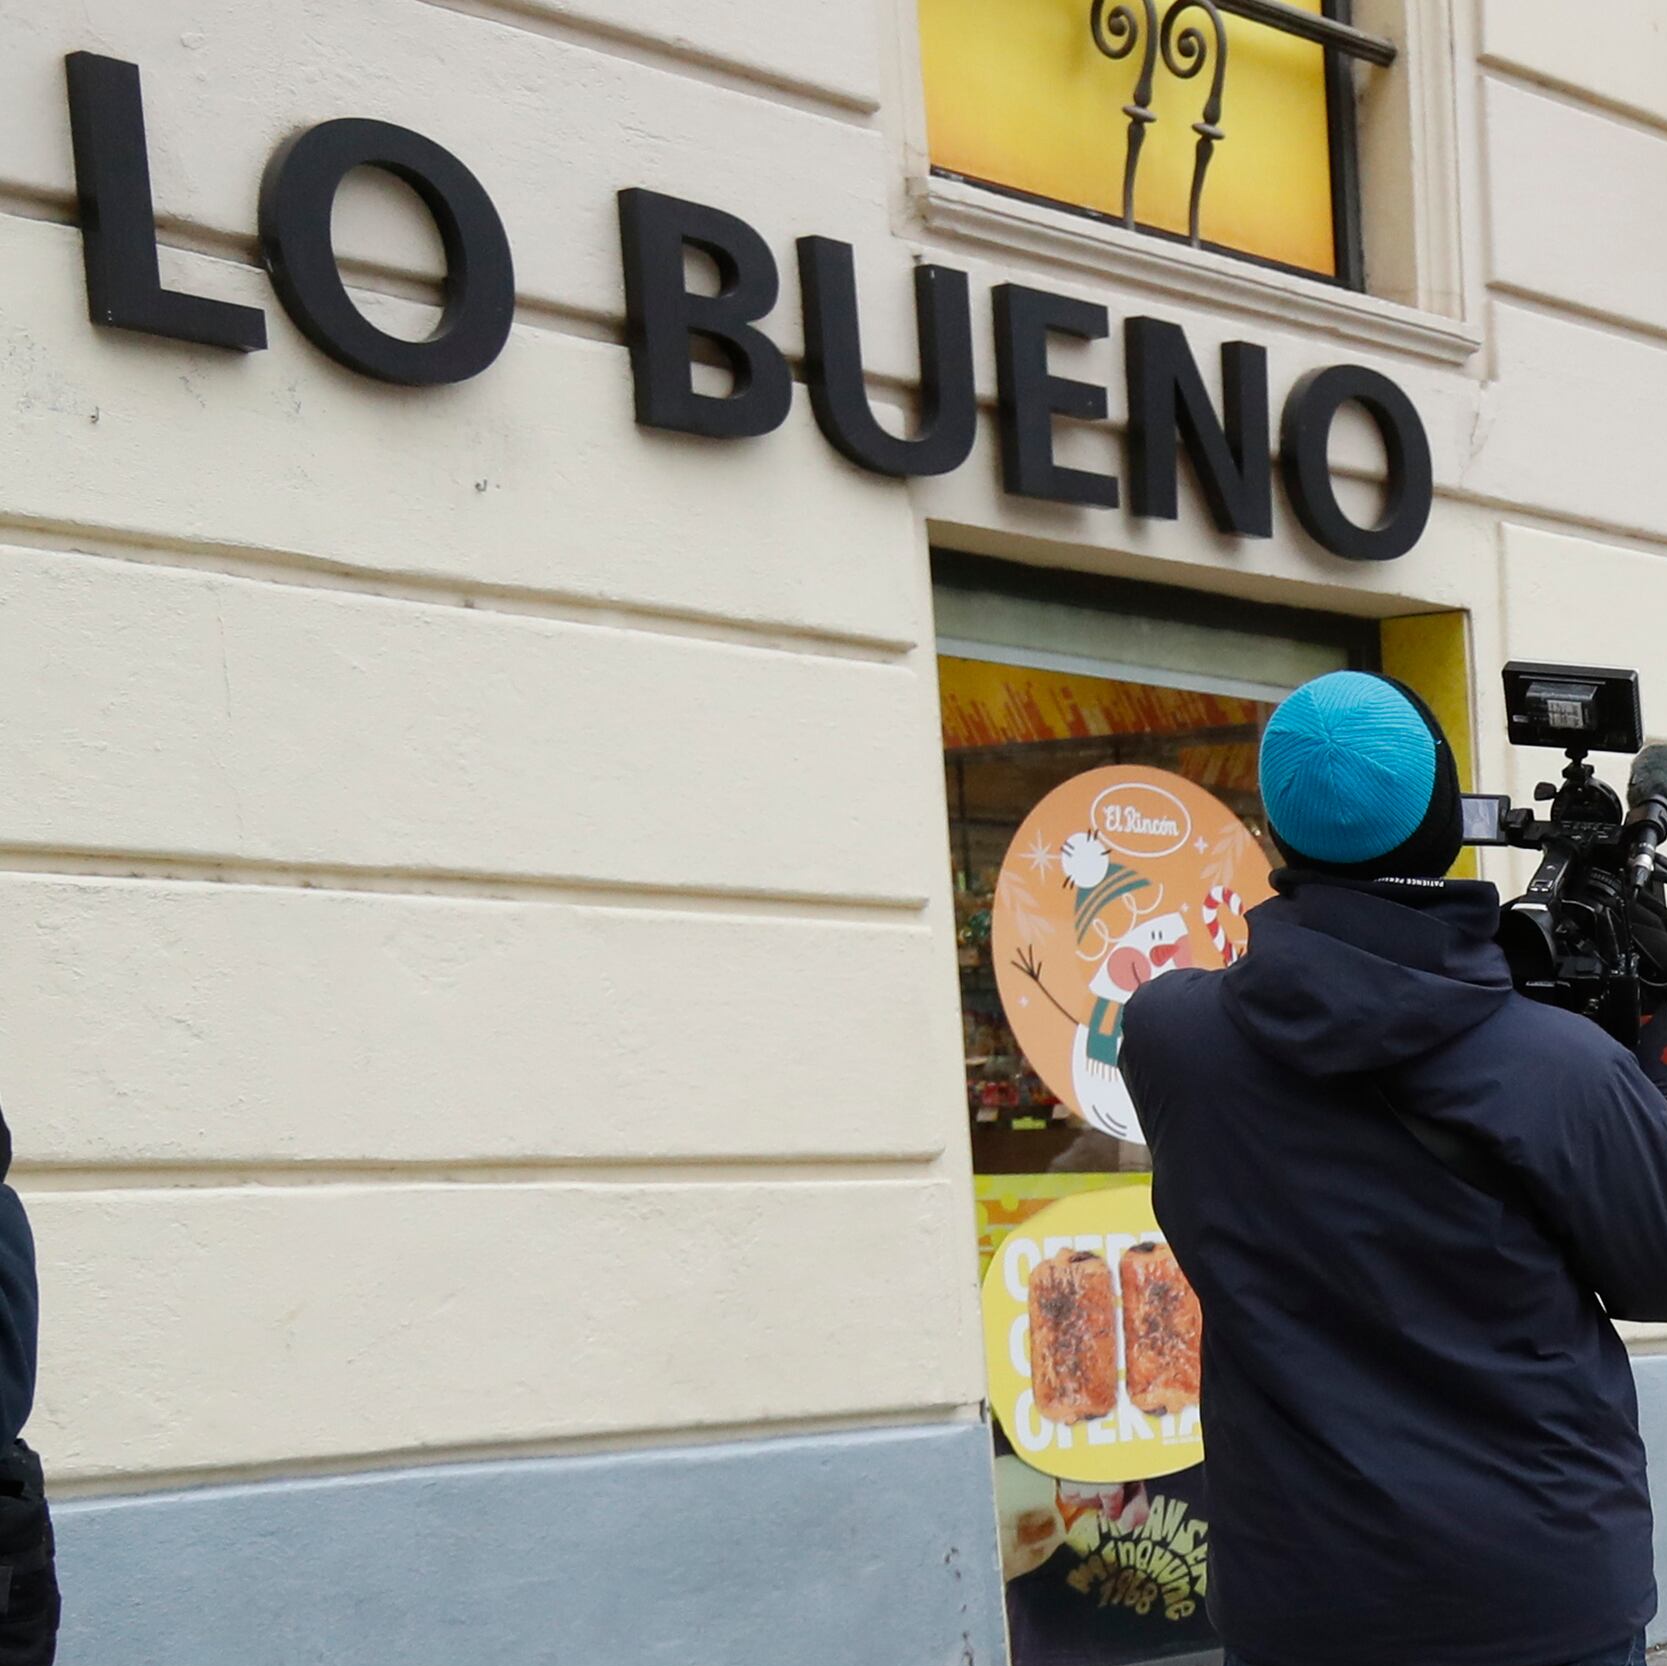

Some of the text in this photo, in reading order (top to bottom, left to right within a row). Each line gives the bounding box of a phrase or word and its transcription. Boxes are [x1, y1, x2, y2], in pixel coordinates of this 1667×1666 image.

[65, 50, 1434, 562] LO BUENO
[1104, 805, 1180, 837] El Rincón
